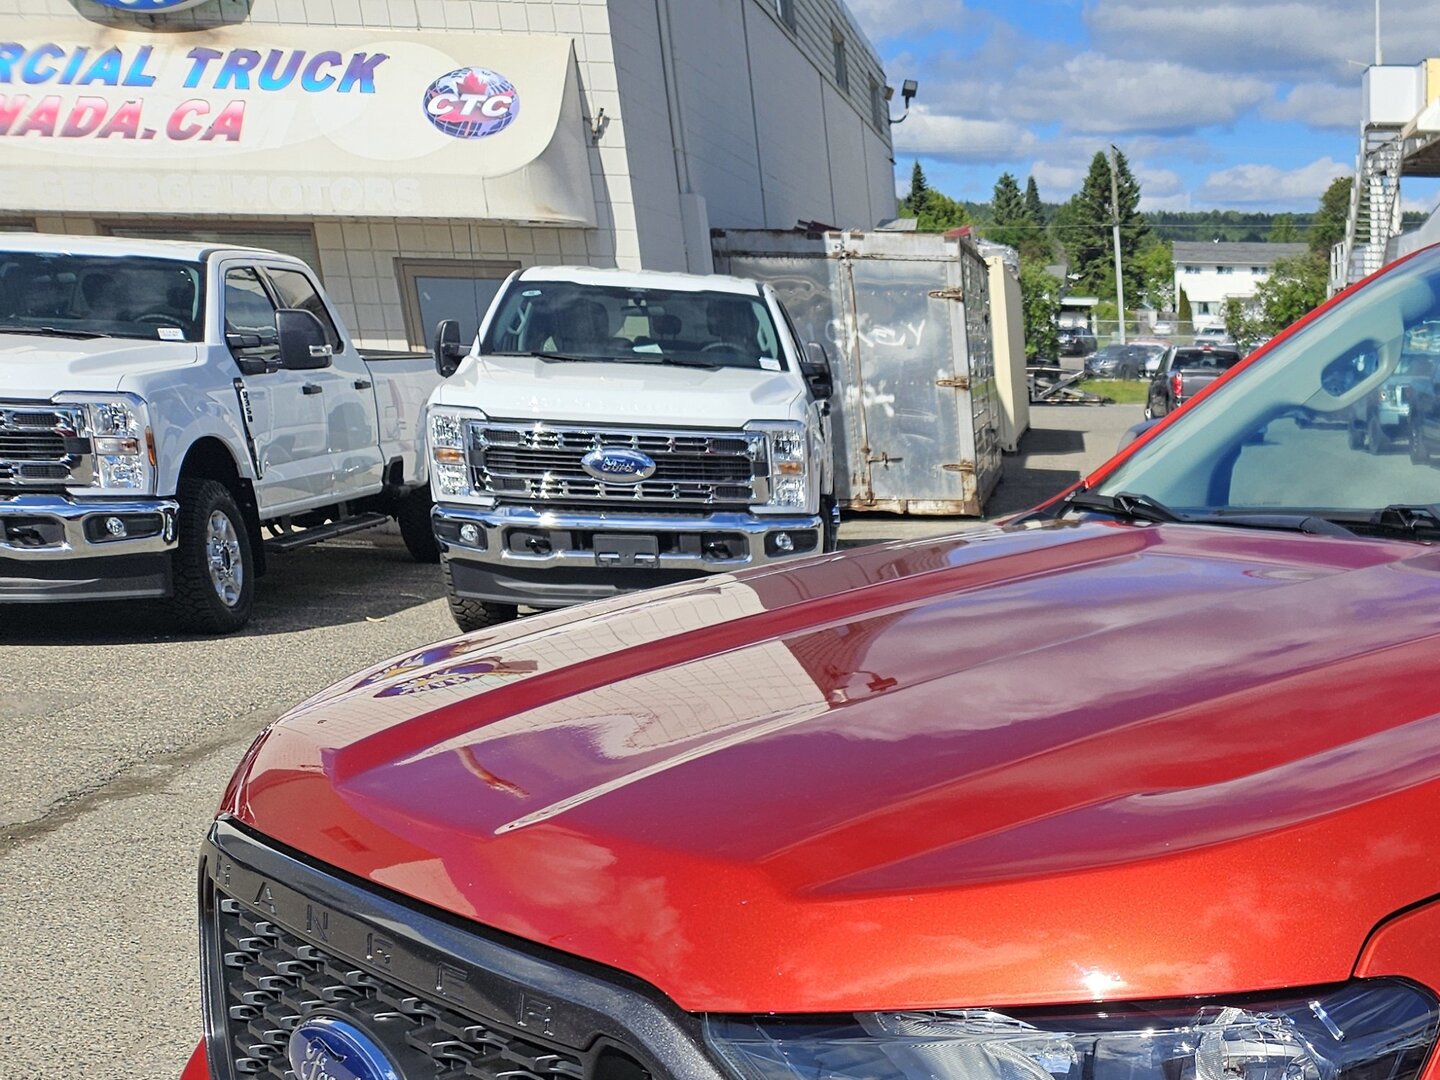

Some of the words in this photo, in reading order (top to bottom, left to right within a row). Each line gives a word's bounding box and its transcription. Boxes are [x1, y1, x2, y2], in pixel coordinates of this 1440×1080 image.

[183, 47, 390, 94] TRUCK
[427, 93, 513, 117] CTC
[230, 174, 421, 211] MOTORS
